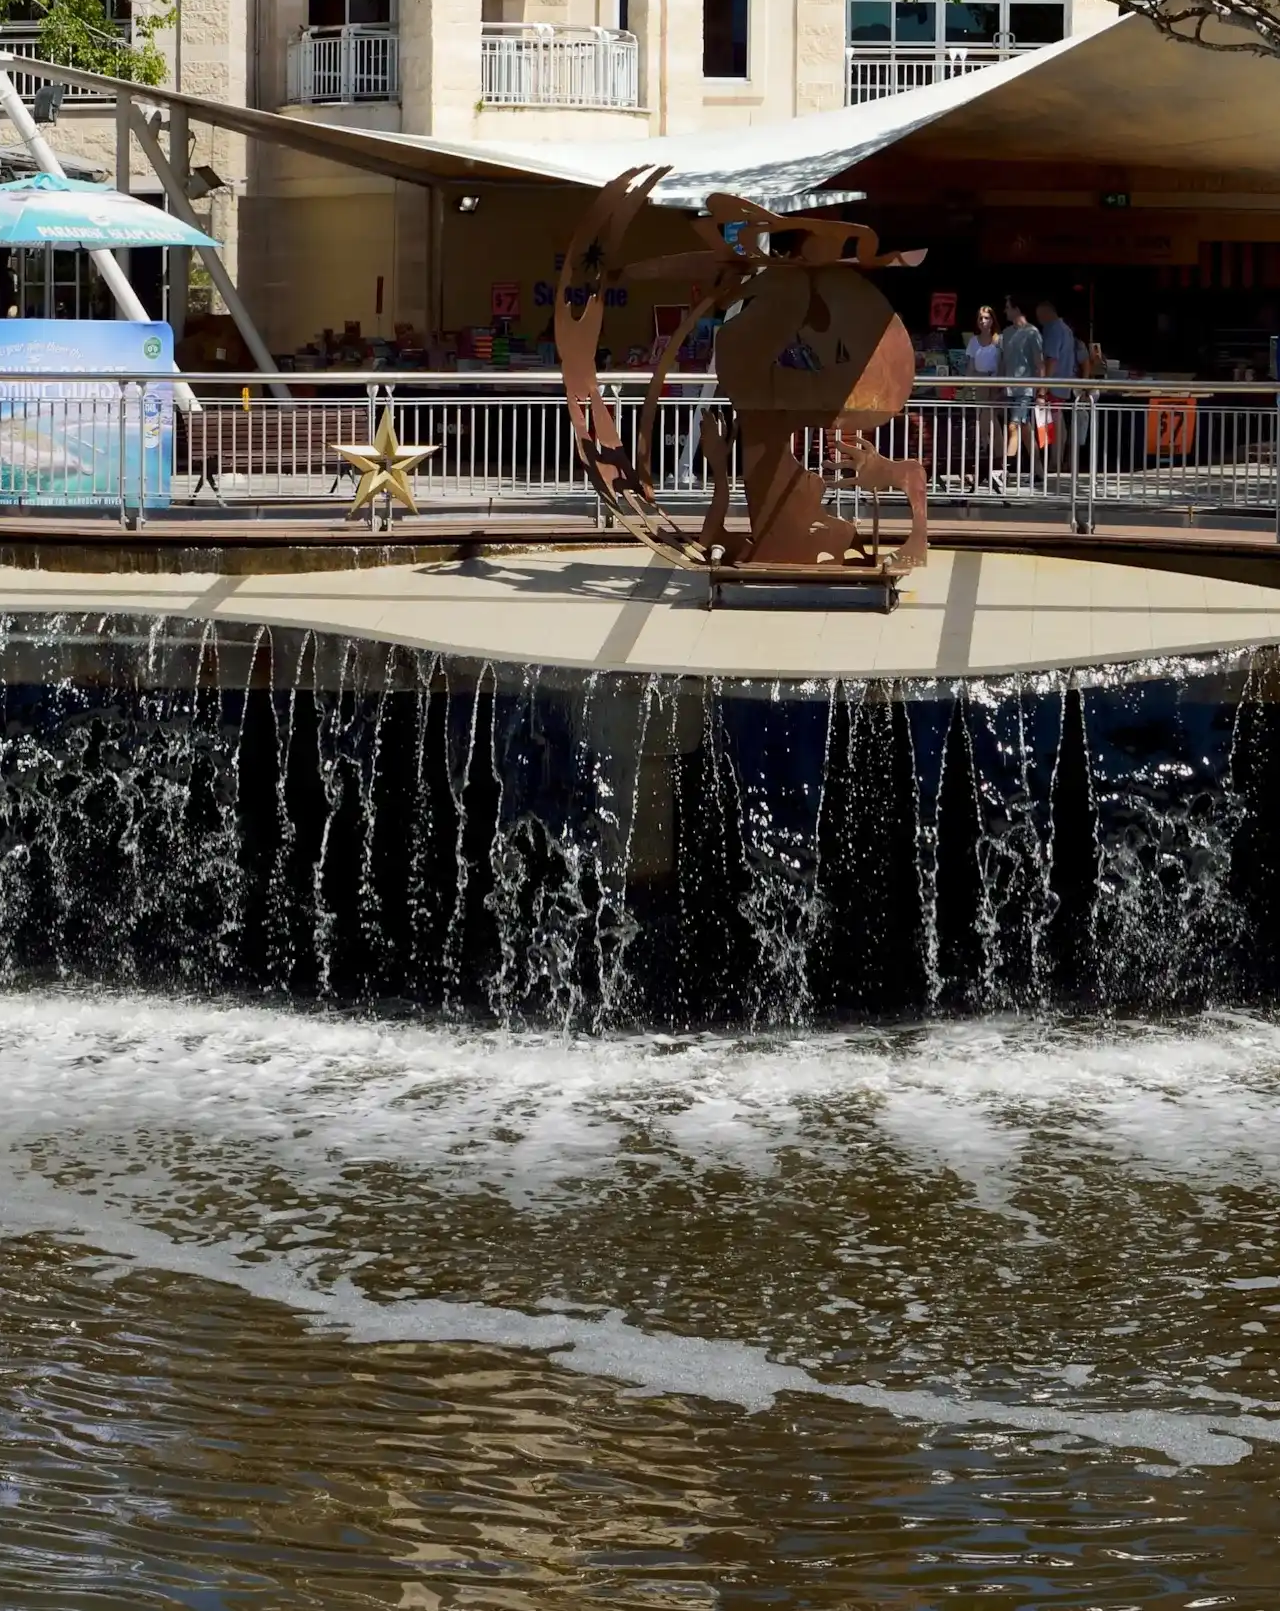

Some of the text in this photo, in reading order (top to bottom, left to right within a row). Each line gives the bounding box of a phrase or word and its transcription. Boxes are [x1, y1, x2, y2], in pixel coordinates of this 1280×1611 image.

[36, 225, 107, 239] PARADISE
[495, 292, 518, 311] $7
[533, 281, 628, 306] Sunshne
[57, 366, 128, 402] COAST
